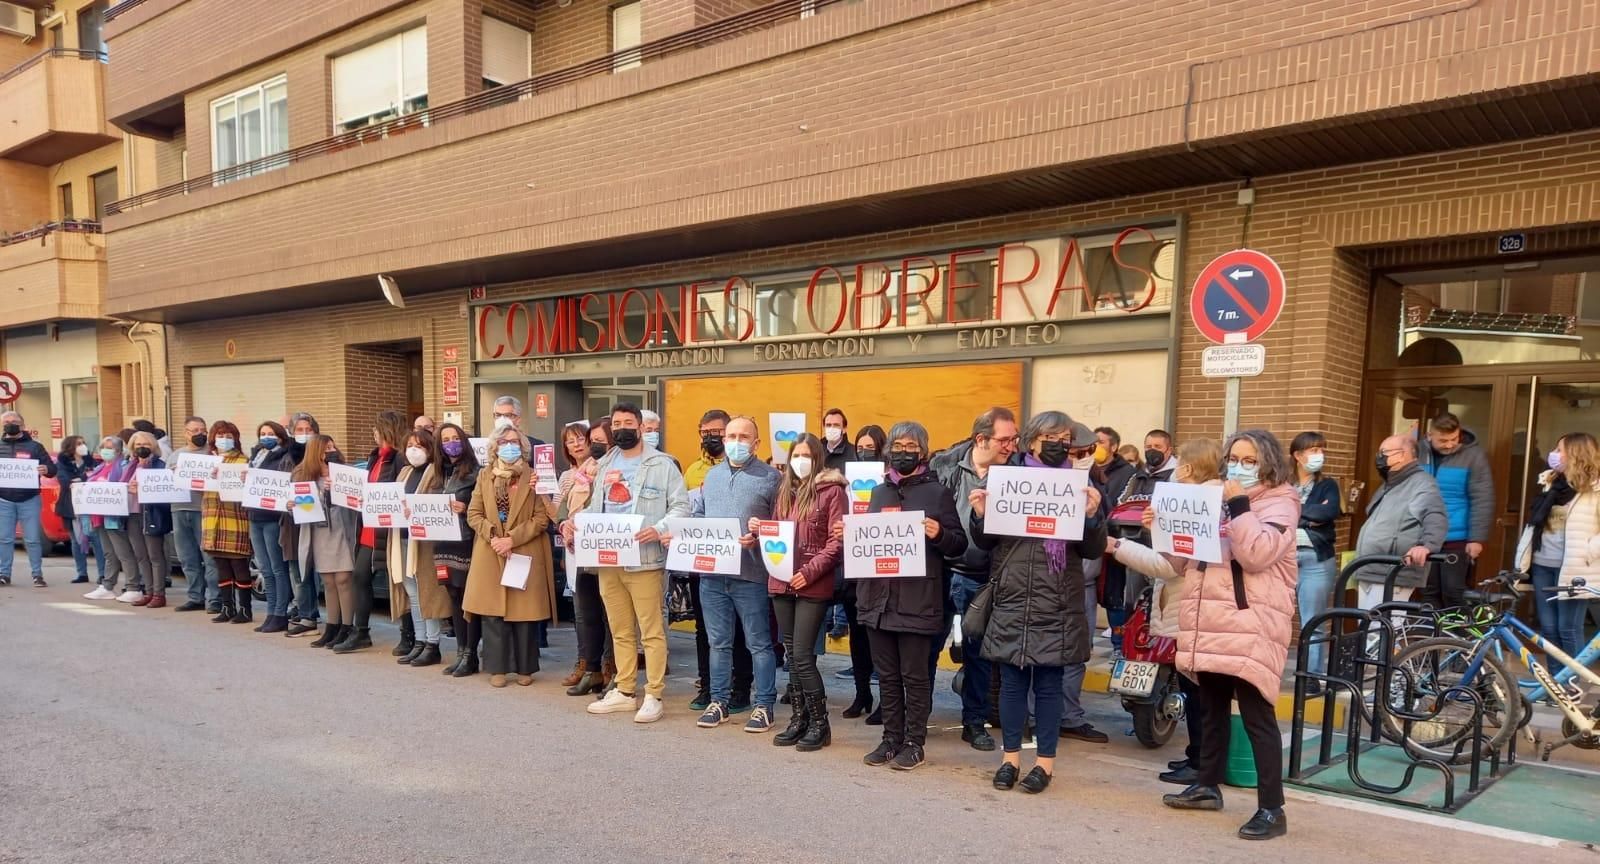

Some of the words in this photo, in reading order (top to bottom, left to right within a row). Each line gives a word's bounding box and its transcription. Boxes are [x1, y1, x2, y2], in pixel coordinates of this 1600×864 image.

[1502, 237, 1521, 250] 32B
[479, 276, 755, 358] COMISIONES
[806, 227, 1157, 334] OBRERAS
[1217, 310, 1225, 320] 7
[1225, 311, 1240, 320] m.
[516, 358, 566, 374] FOREM
[625, 347, 724, 369] FUNDACION
[752, 337, 875, 361] FORMACION
[906, 334, 927, 352] Y
[957, 323, 1061, 350] EMPLEO
[1211, 347, 1255, 355] RESERVADO
[271, 478, 278, 487] A
[1001, 480, 1033, 497] ¡NO
[1036, 481, 1048, 496] A
[1052, 483, 1074, 497] LA
[368, 491, 381, 502] ¡NO
[382, 491, 389, 500] A
[389, 491, 399, 500] LA
[366, 504, 401, 513] GUERRA!
[413, 503, 429, 515] ¡NO
[430, 504, 438, 513] A
[995, 499, 1076, 518] GUERRA!
[1157, 497, 1178, 514] ¡NO
[1181, 499, 1191, 514] A
[1192, 499, 1210, 516] LA
[412, 517, 454, 527] GUERRA!
[1028, 521, 1054, 529] CCOO
[1158, 517, 1212, 539] GUERRA!
[583, 523, 604, 536] ¡NO
[606, 523, 615, 533] A
[617, 523, 632, 534] LA
[680, 528, 703, 541] ¡NO
[706, 528, 714, 539] A
[717, 529, 734, 540] LA
[855, 525, 880, 542] ¡NO
[884, 525, 894, 538] A
[897, 524, 915, 538] LA
[580, 538, 634, 550] GUERRA!
[677, 542, 736, 557] GUERRA!
[852, 543, 917, 558] GUERRA!
[1123, 663, 1154, 678] 4384
[1122, 677, 1147, 691] GDN
